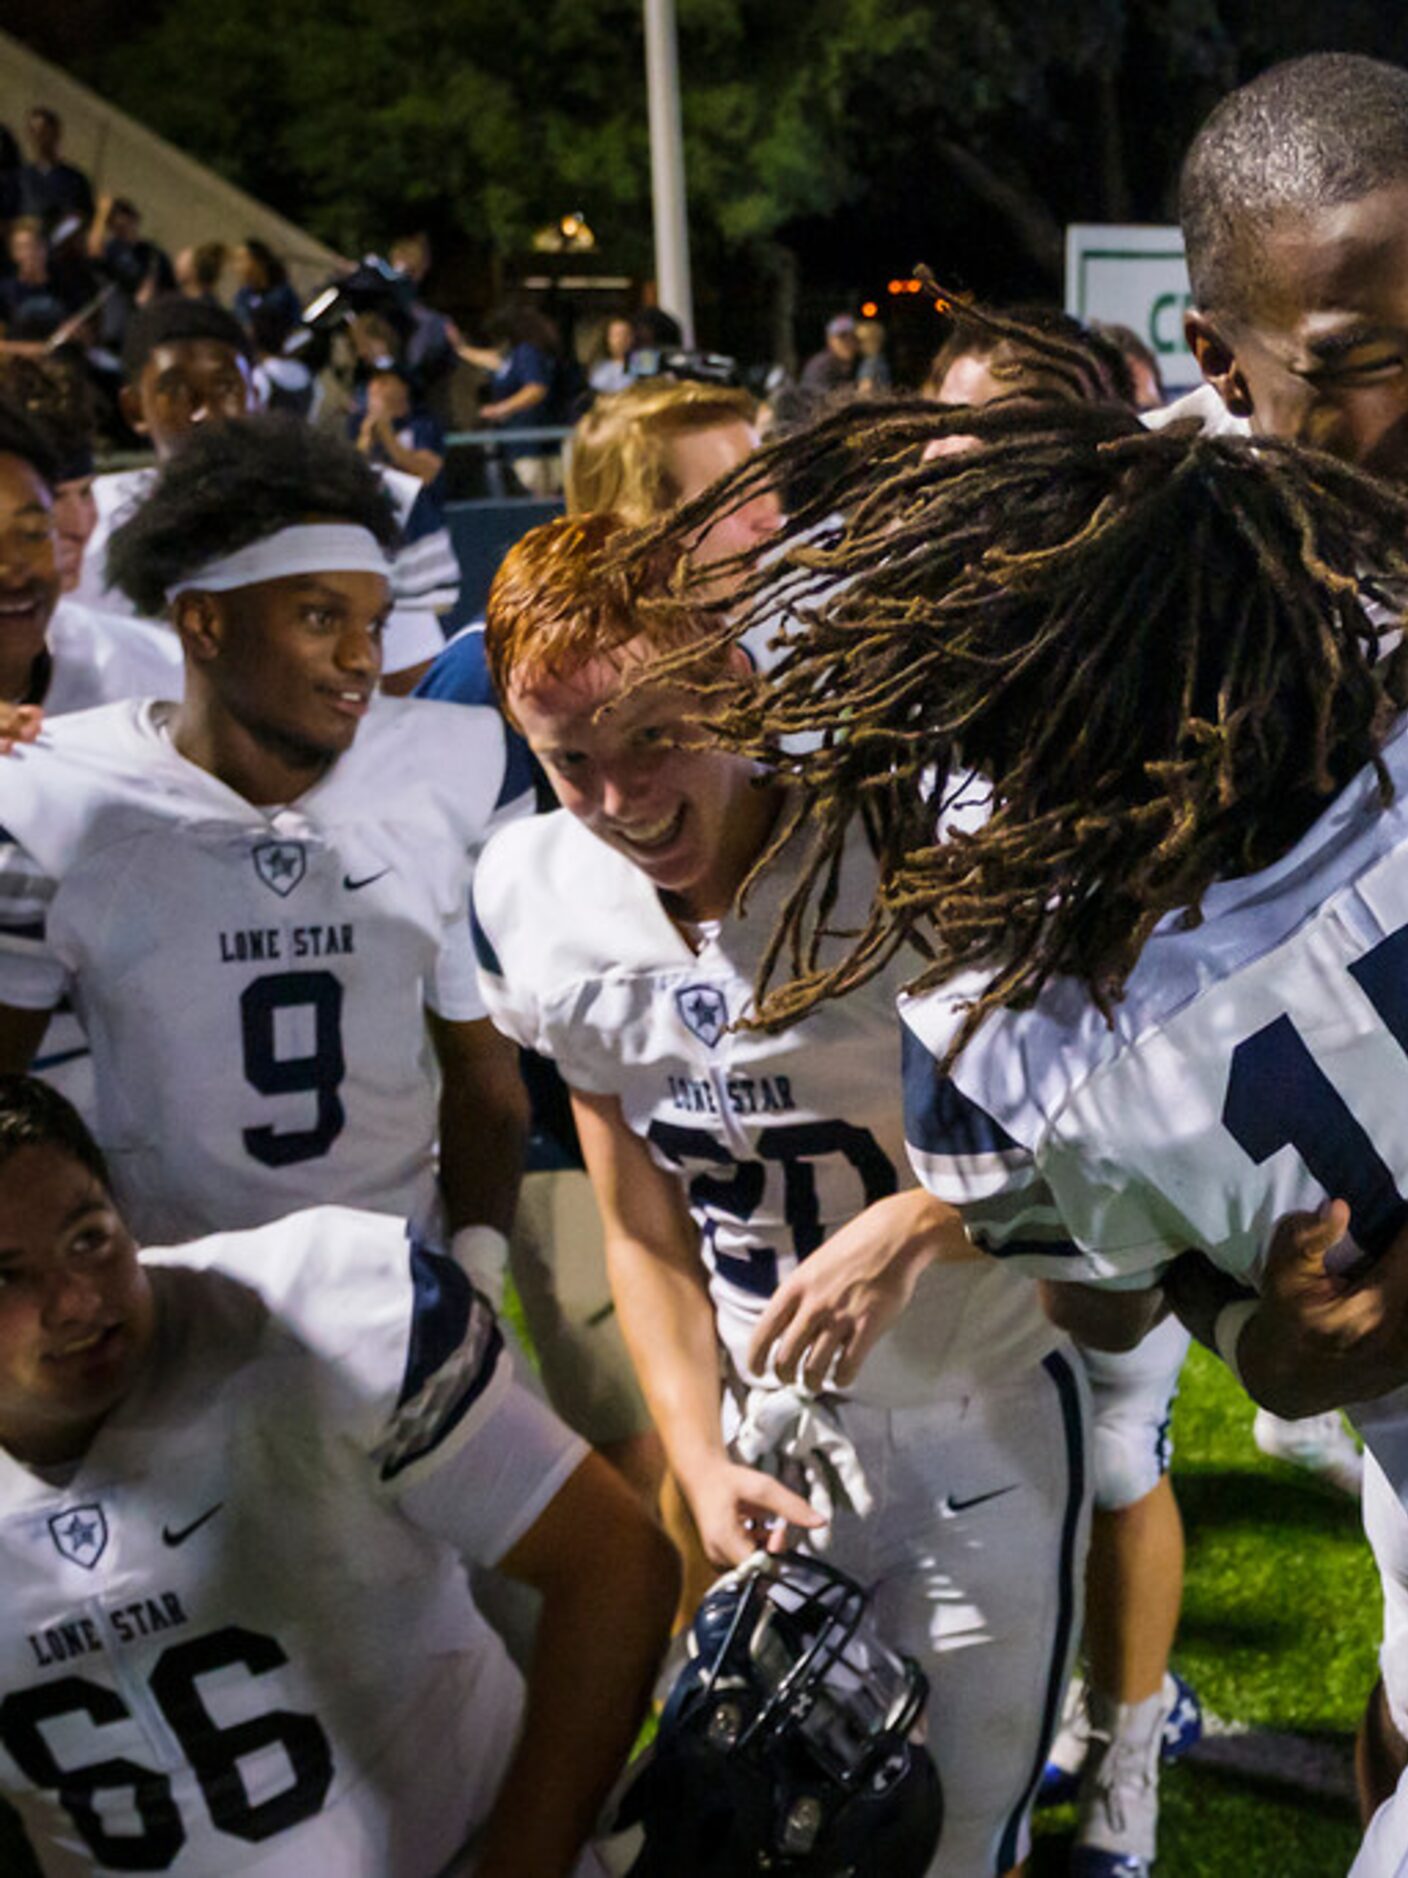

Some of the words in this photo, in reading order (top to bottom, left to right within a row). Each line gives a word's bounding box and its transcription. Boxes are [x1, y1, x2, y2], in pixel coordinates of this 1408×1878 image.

[219, 928, 281, 963] LONE
[293, 924, 355, 957] STAR
[239, 969, 346, 1170] 9
[726, 1074, 797, 1113] STAR
[27, 1619, 104, 1667] LONE
[109, 1591, 188, 1644] STAR
[0, 1625, 336, 1872] 66
